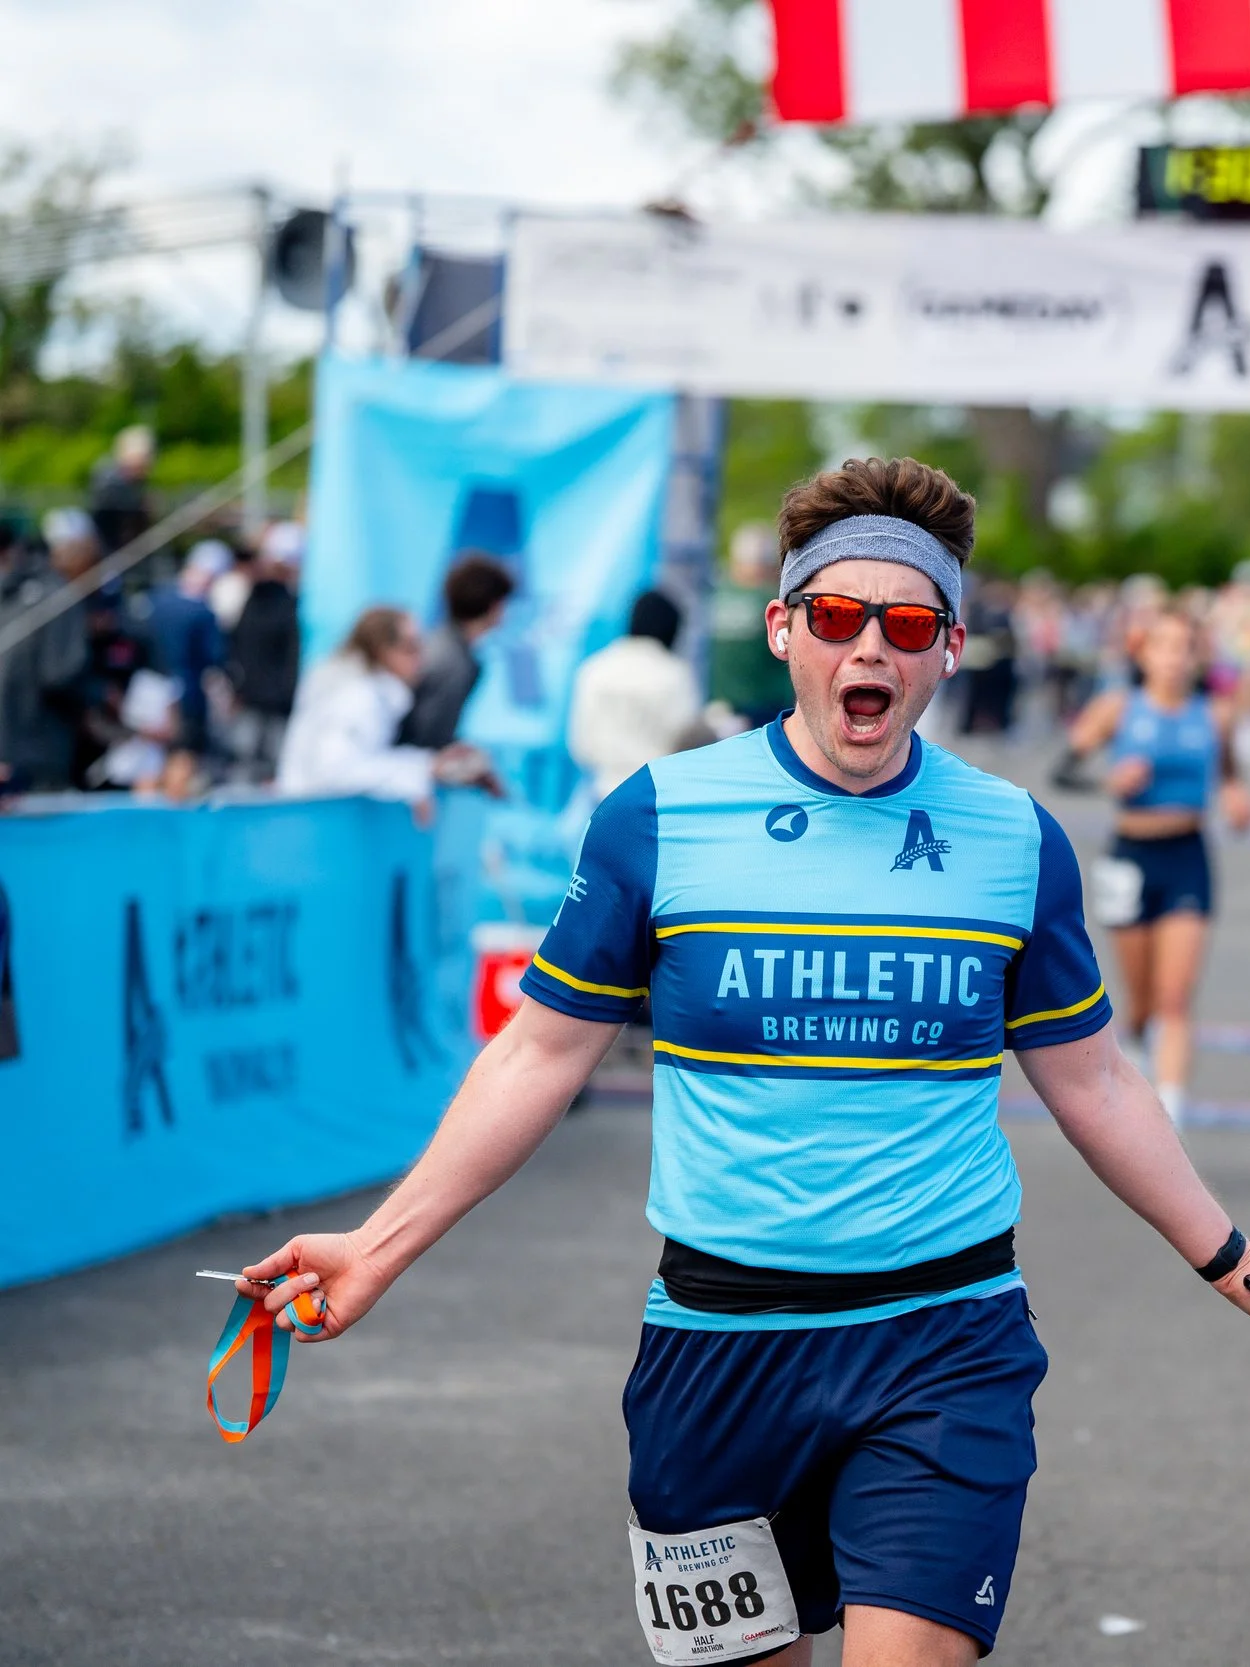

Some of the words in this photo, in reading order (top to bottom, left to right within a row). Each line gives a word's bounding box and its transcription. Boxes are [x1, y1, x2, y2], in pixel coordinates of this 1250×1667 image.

[717, 949, 982, 1007] ATHLETIC
[762, 1016, 900, 1043] BREWING
[664, 1536, 736, 1560] ATHLETIC
[678, 1559, 716, 1572] BREWING
[644, 1571, 765, 1631] 1688
[693, 1634, 716, 1646] HALF
[744, 1626, 780, 1641] GAMEDAY
[691, 1643, 724, 1655] MARATHON
